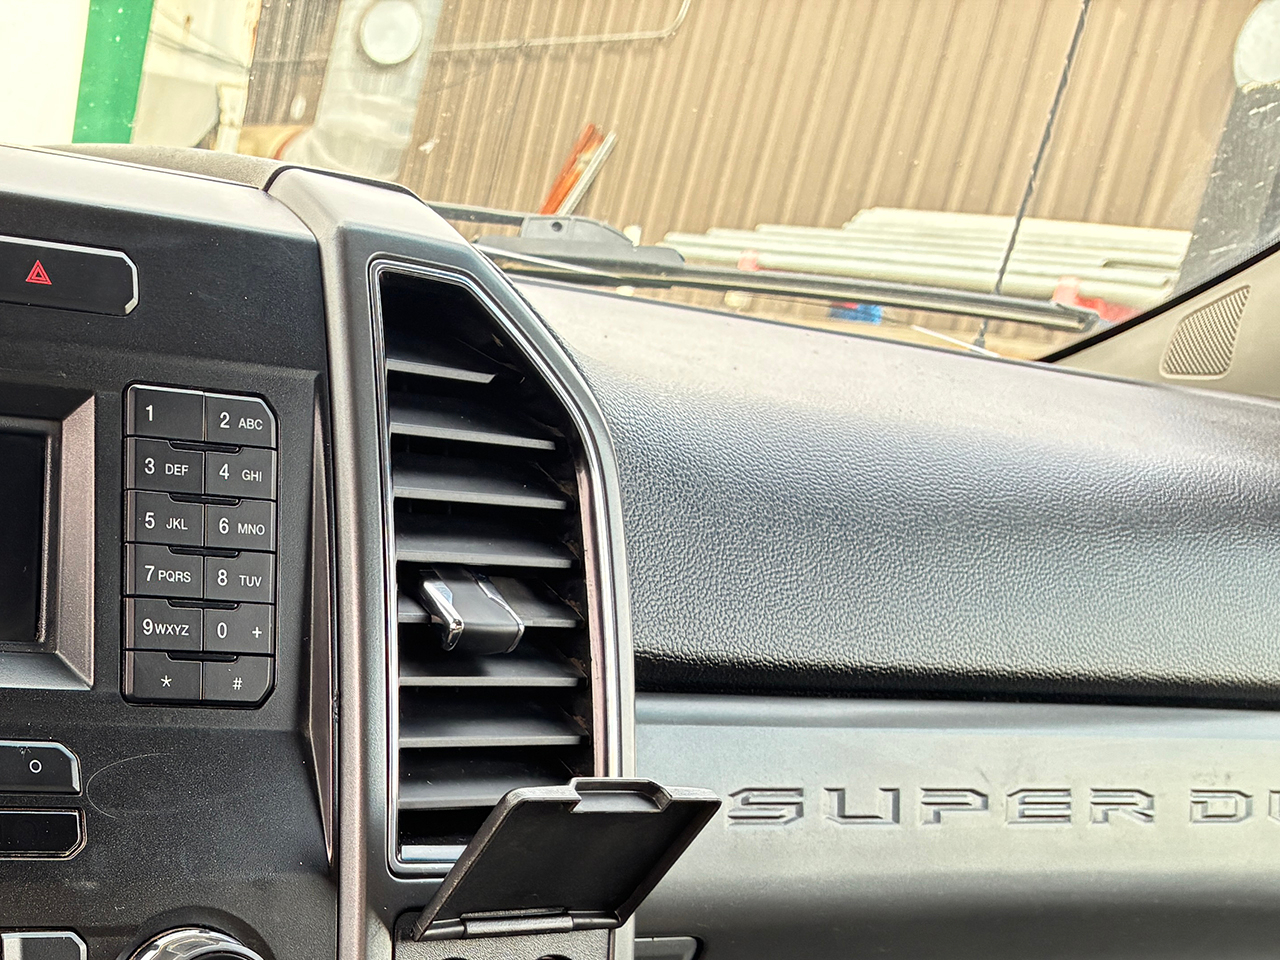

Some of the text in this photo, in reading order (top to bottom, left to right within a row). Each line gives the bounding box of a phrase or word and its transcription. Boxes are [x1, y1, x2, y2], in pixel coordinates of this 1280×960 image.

[145, 404, 153, 422] 1
[219, 411, 263, 431] 2 ABC
[144, 457, 189, 476] 3 DEF
[218, 463, 262, 483] 4 GHI
[144, 511, 189, 530] 5 JKL
[219, 517, 266, 536] 6 MNO
[144, 564, 192, 583] 7 PQRS
[217, 569, 262, 587] 8 TUV
[217, 622, 228, 639] 0
[727, 786, 1280, 825] SUPER D
